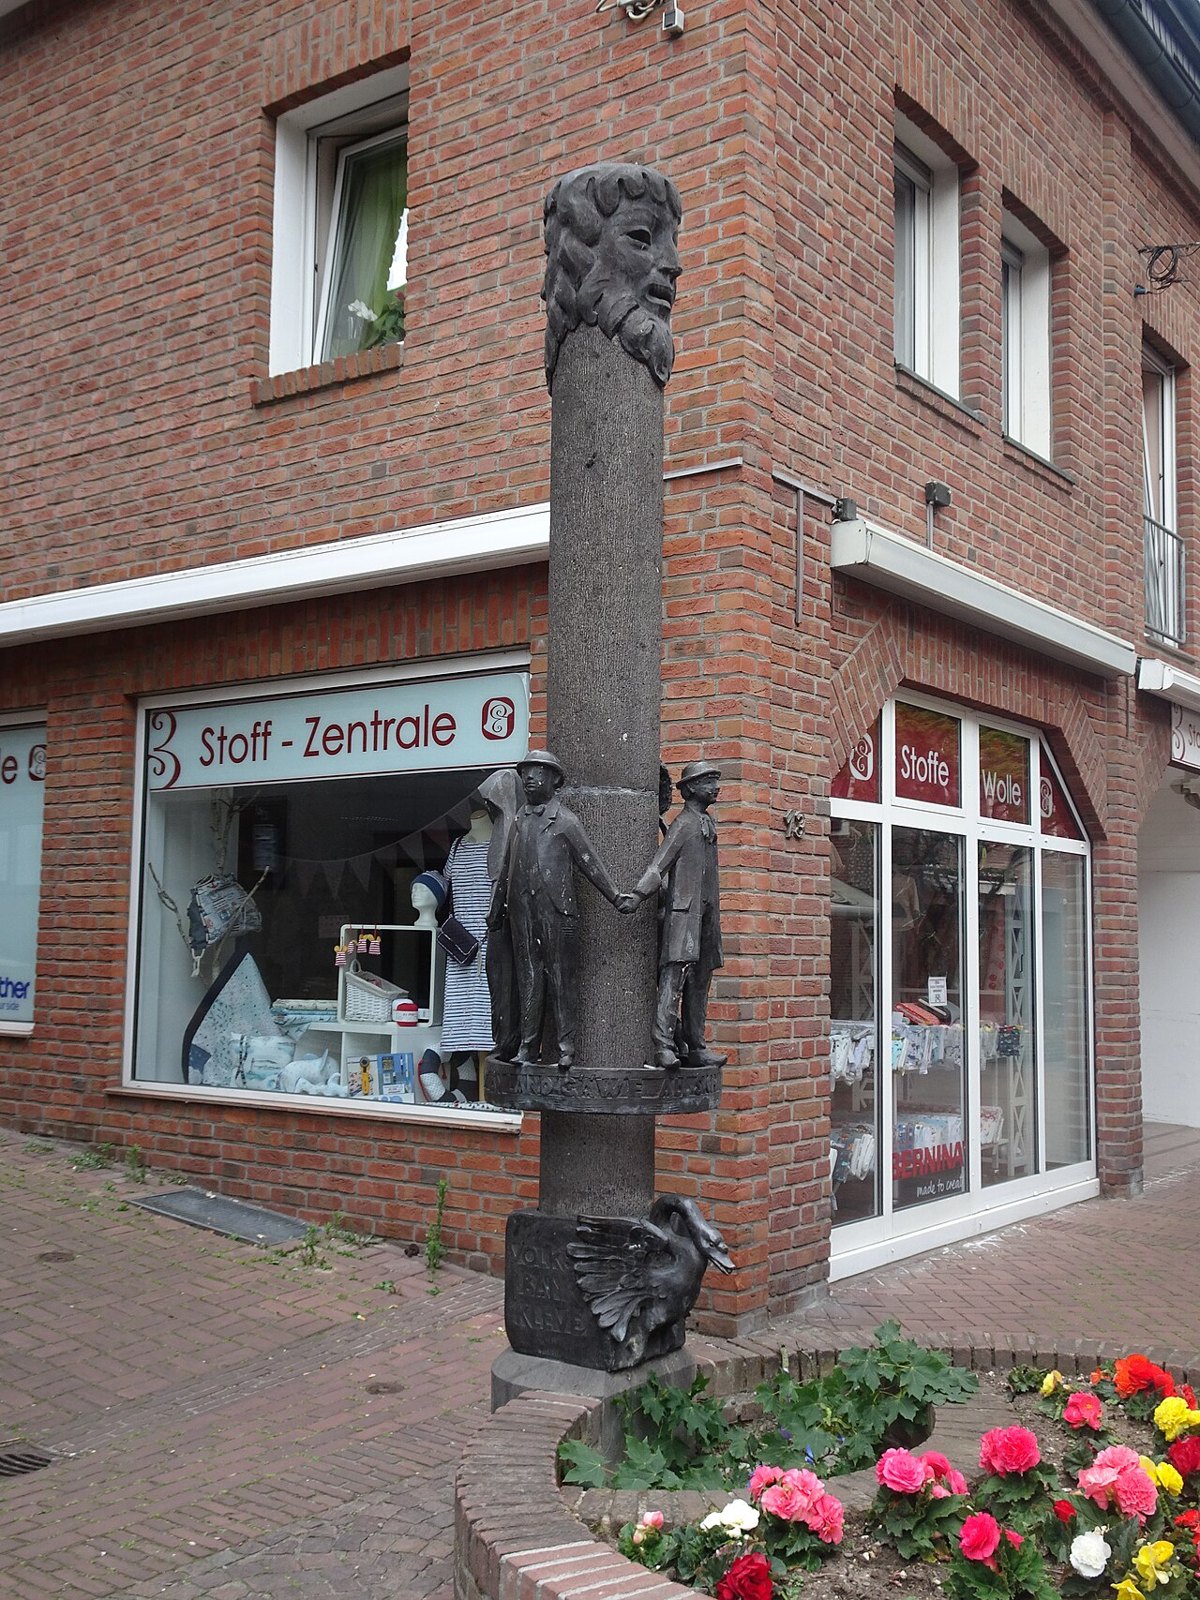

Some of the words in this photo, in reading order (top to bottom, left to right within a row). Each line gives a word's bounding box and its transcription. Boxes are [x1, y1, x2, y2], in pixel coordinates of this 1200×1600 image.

[200, 720, 272, 766] Stoff
[303, 705, 457, 757] Zentrale
[901, 744, 949, 787] Stoffe
[982, 769, 1021, 806] Wolle
[892, 1141, 963, 1181] BERNINA
[916, 1180, 936, 1197] made
[937, 1179, 945, 1192] to
[947, 1176, 964, 1190] creat
